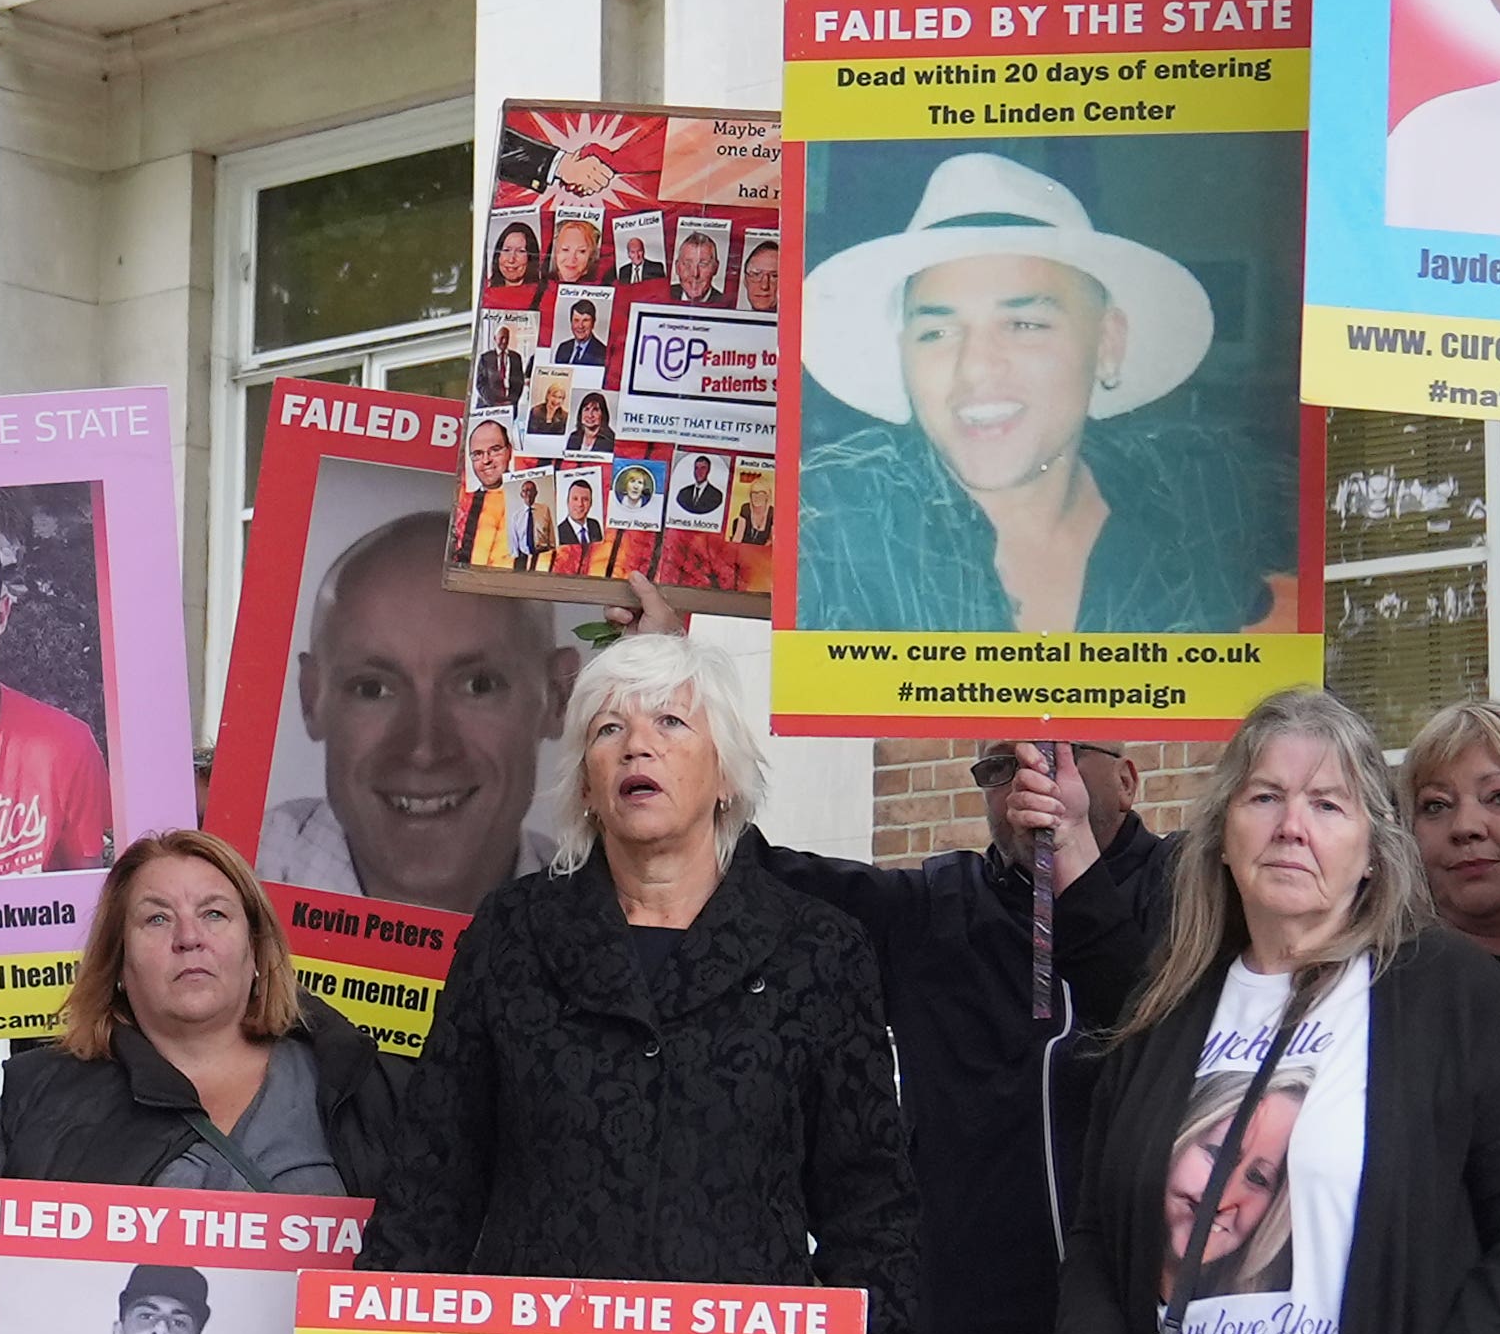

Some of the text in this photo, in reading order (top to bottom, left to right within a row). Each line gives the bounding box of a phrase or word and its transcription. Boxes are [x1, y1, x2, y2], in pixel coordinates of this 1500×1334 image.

[837, 56, 1272, 87] Dead within 20 days of entering
[927, 100, 1176, 125] The Linden Center
[712, 120, 766, 139] Maybe
[716, 143, 780, 162] one day
[738, 183, 769, 199] had
[760, 349, 777, 366] to
[700, 374, 767, 393] Patients
[623, 411, 753, 433] THE TRUST THAT LET ITS
[291, 900, 444, 951] Kevin Peters
